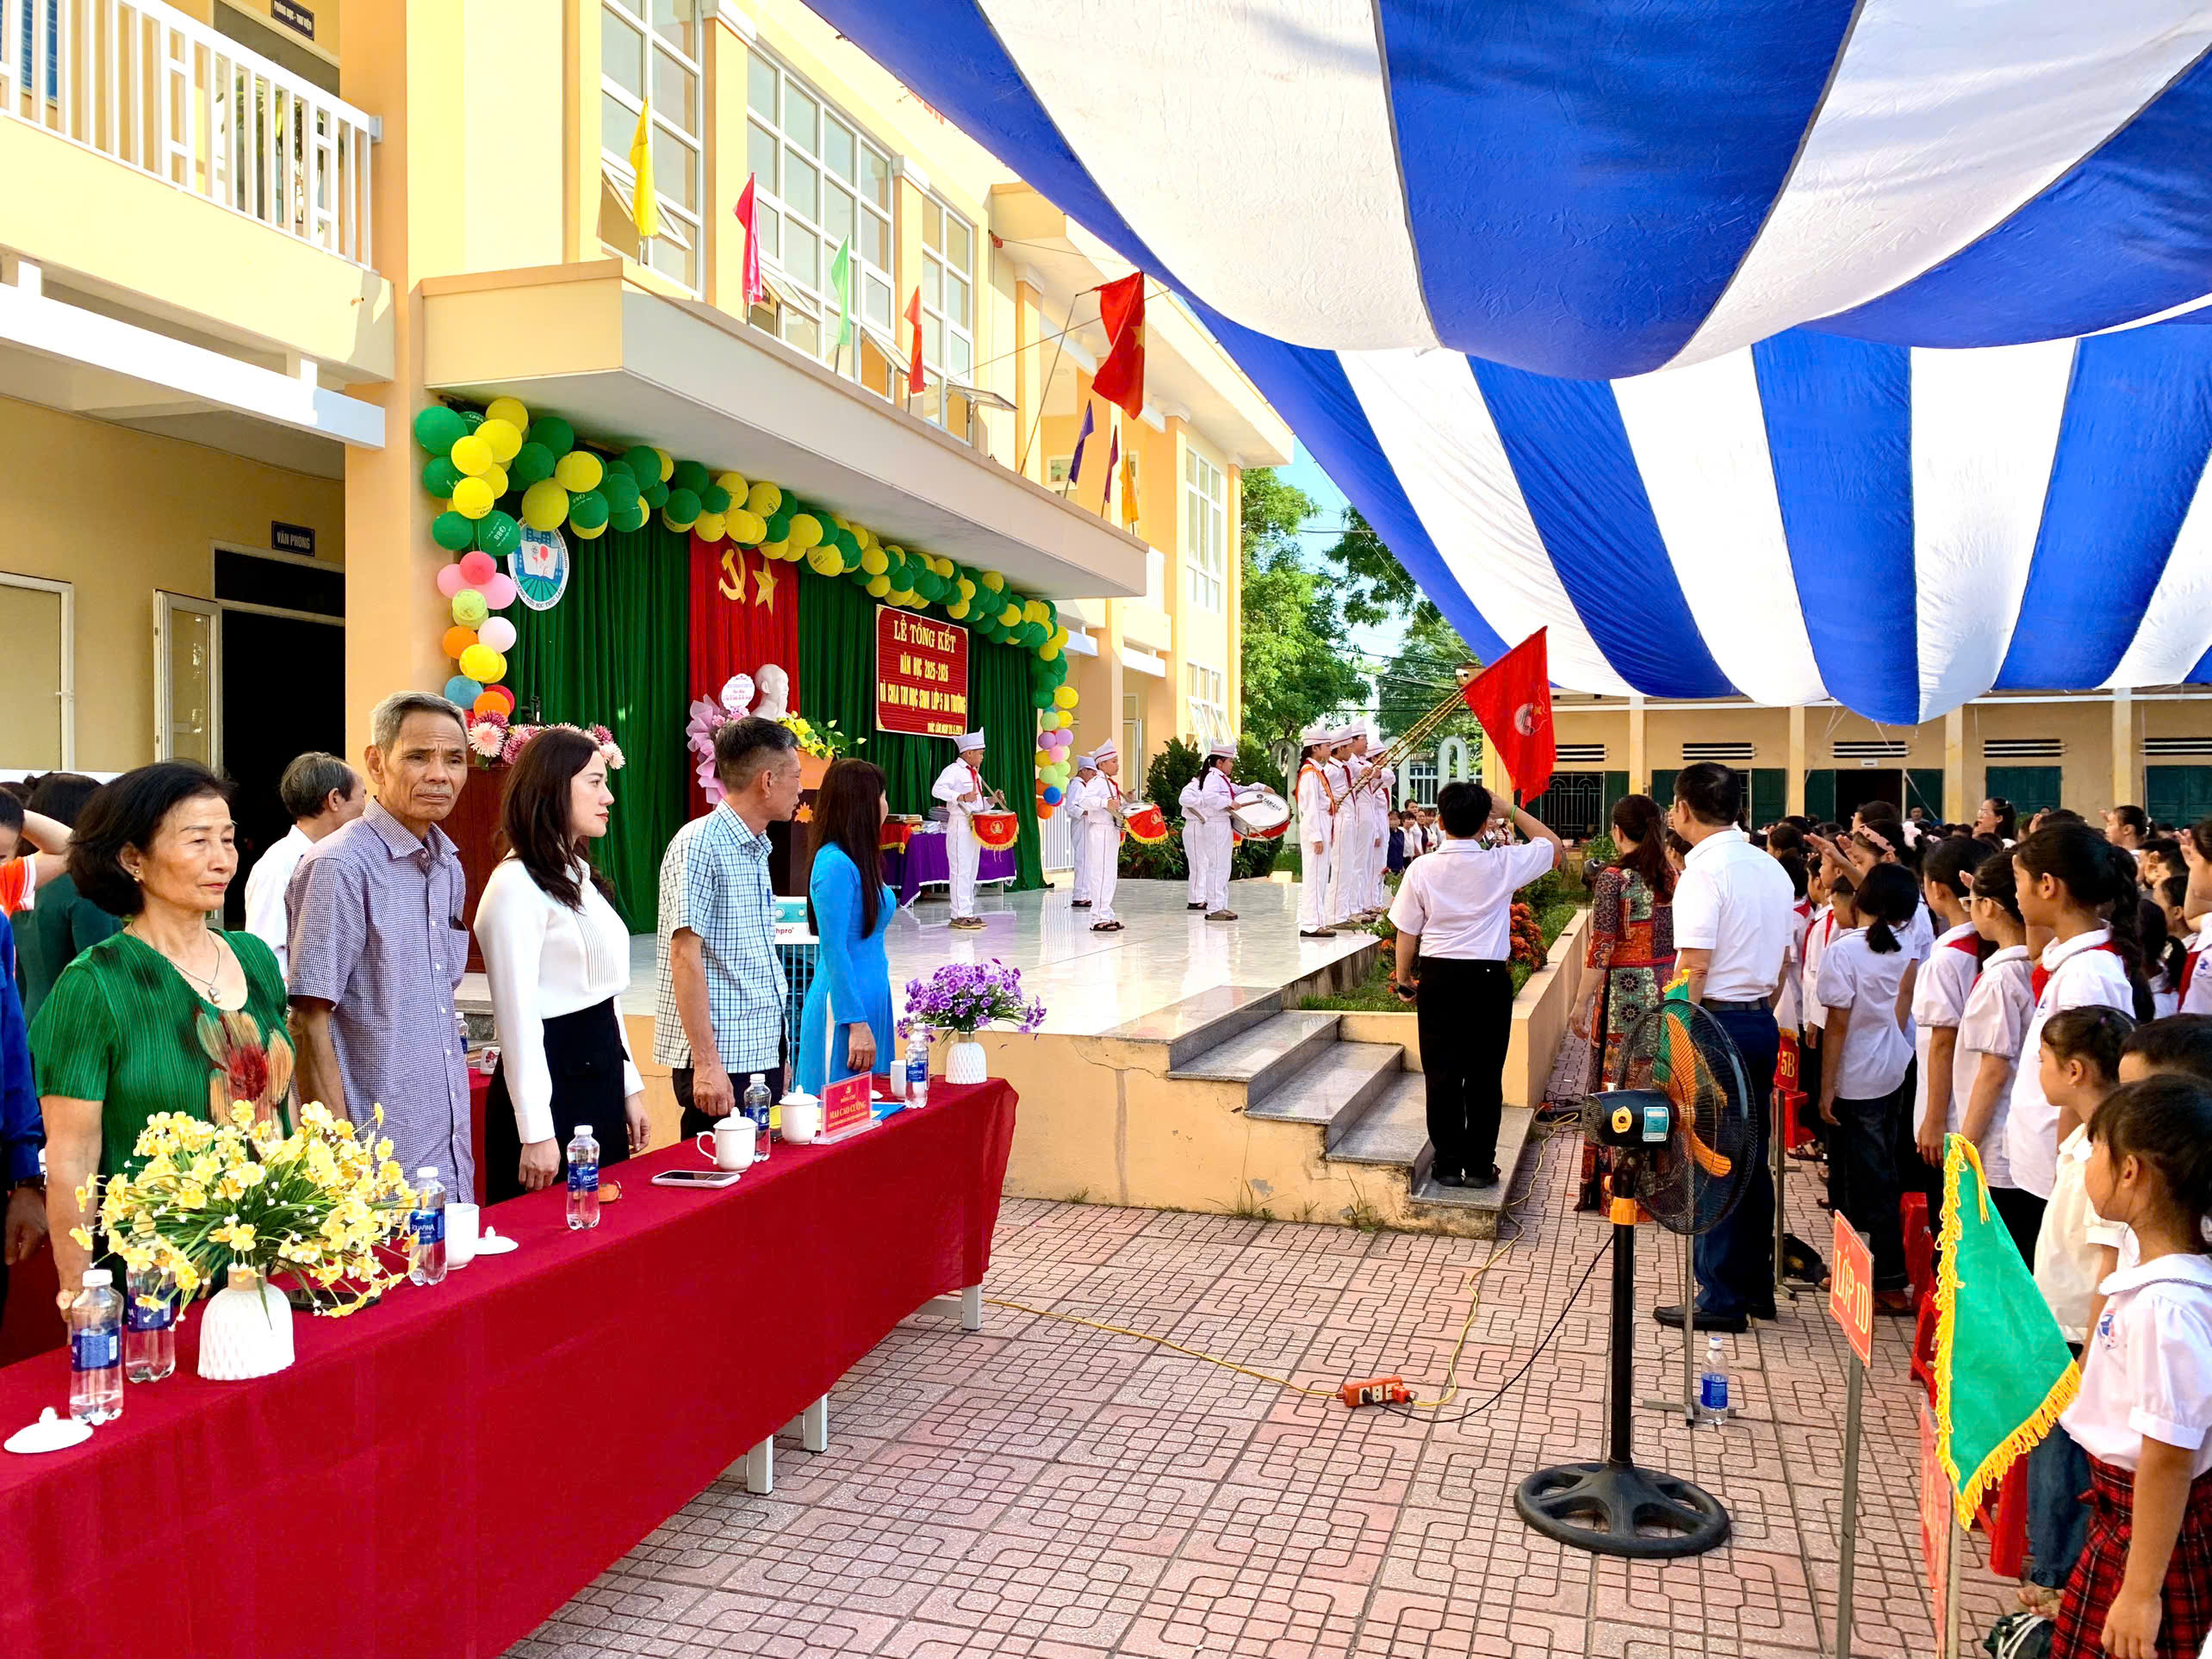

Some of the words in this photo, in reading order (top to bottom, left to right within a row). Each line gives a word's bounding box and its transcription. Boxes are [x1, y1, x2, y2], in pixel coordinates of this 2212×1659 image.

[276, 530, 290, 546] VĂN
[289, 533, 311, 550] PHÒNG
[893, 614, 907, 642] LỄ
[910, 617, 935, 649] TỔNG
[937, 624, 956, 653] KẾT
[899, 651, 910, 675] NĂM
[913, 656, 923, 680] HỌC
[931, 687, 940, 711] LỚP
[1780, 1050, 1795, 1078] 5B
[1835, 1245, 1855, 1314] LỚP
